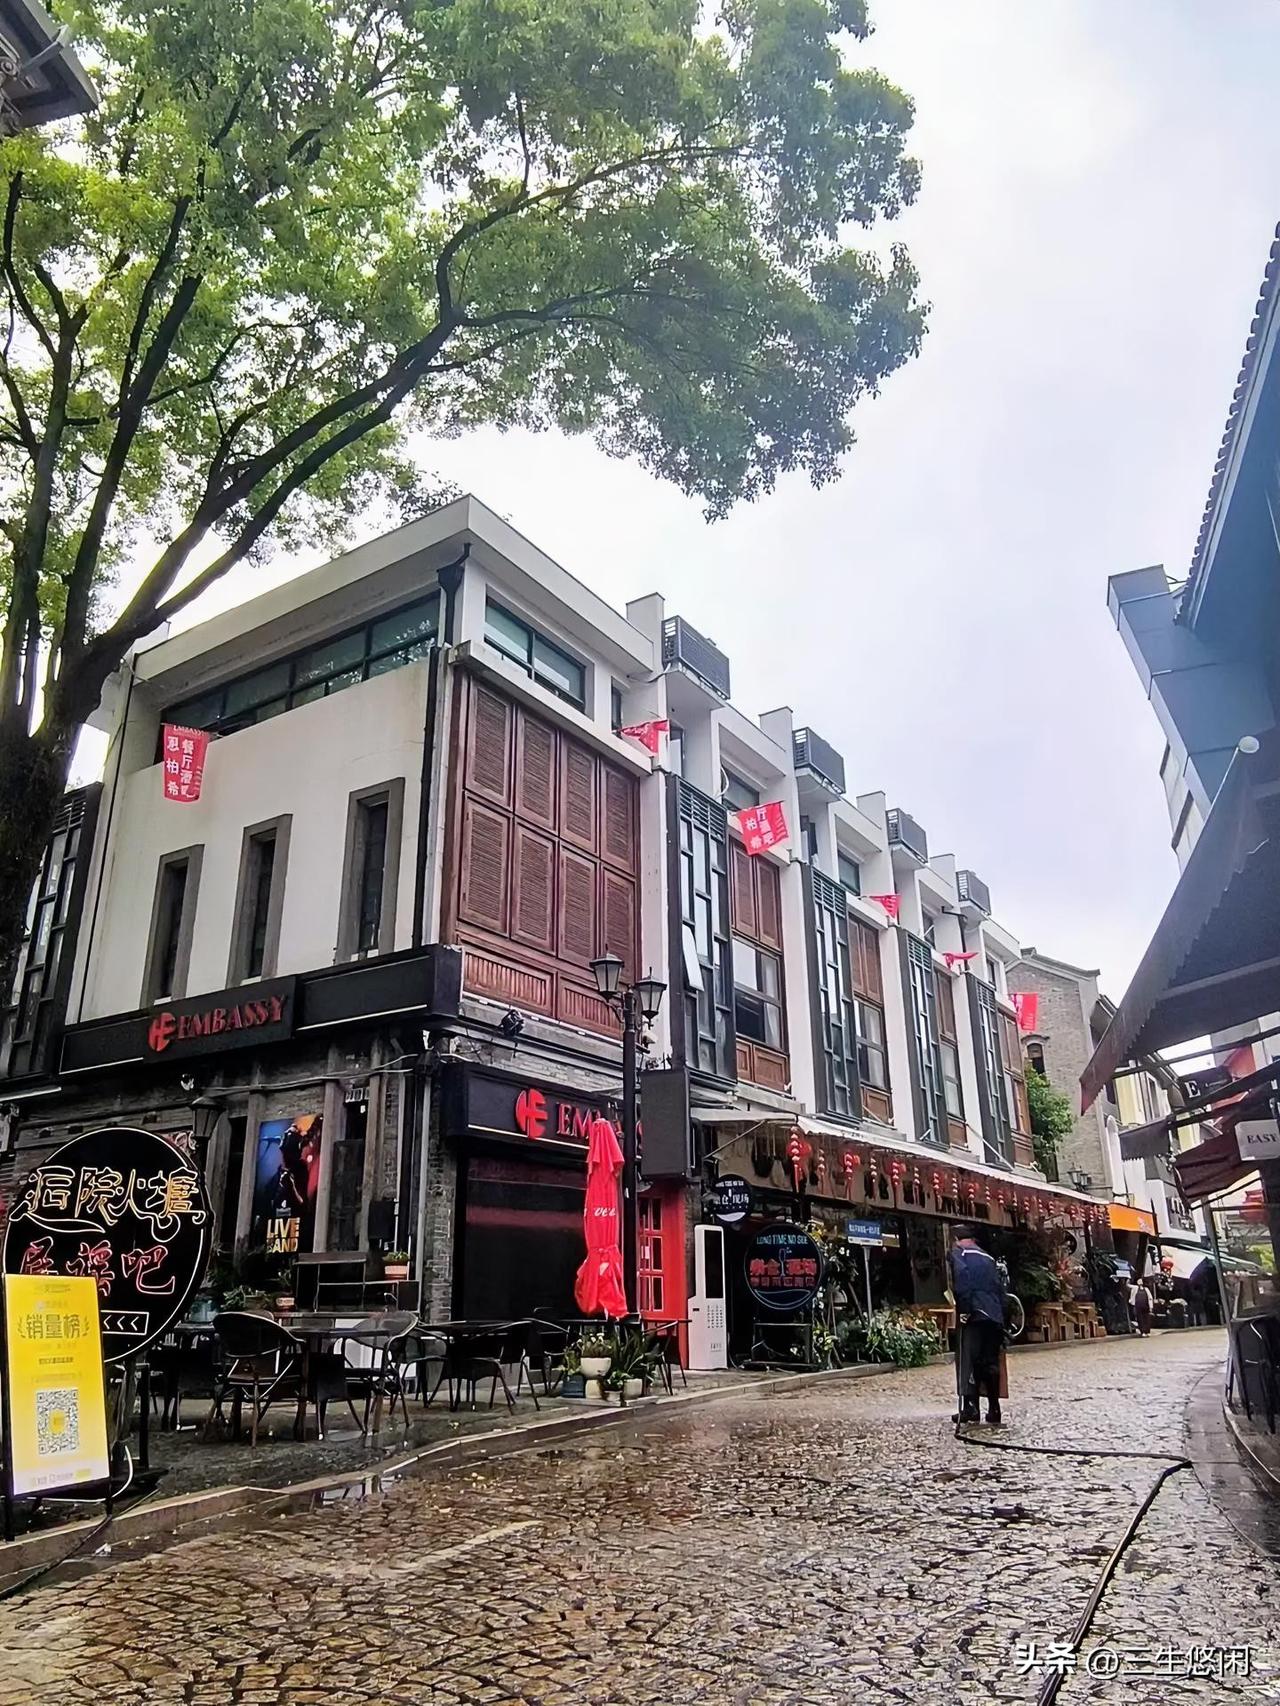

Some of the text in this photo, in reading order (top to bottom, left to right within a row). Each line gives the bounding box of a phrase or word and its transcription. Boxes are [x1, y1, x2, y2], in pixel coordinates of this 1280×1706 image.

[177, 994, 286, 1039] EMBASSY
[266, 1217, 300, 1238] LIVE
[26, 1314, 81, 1339] 销量榜
